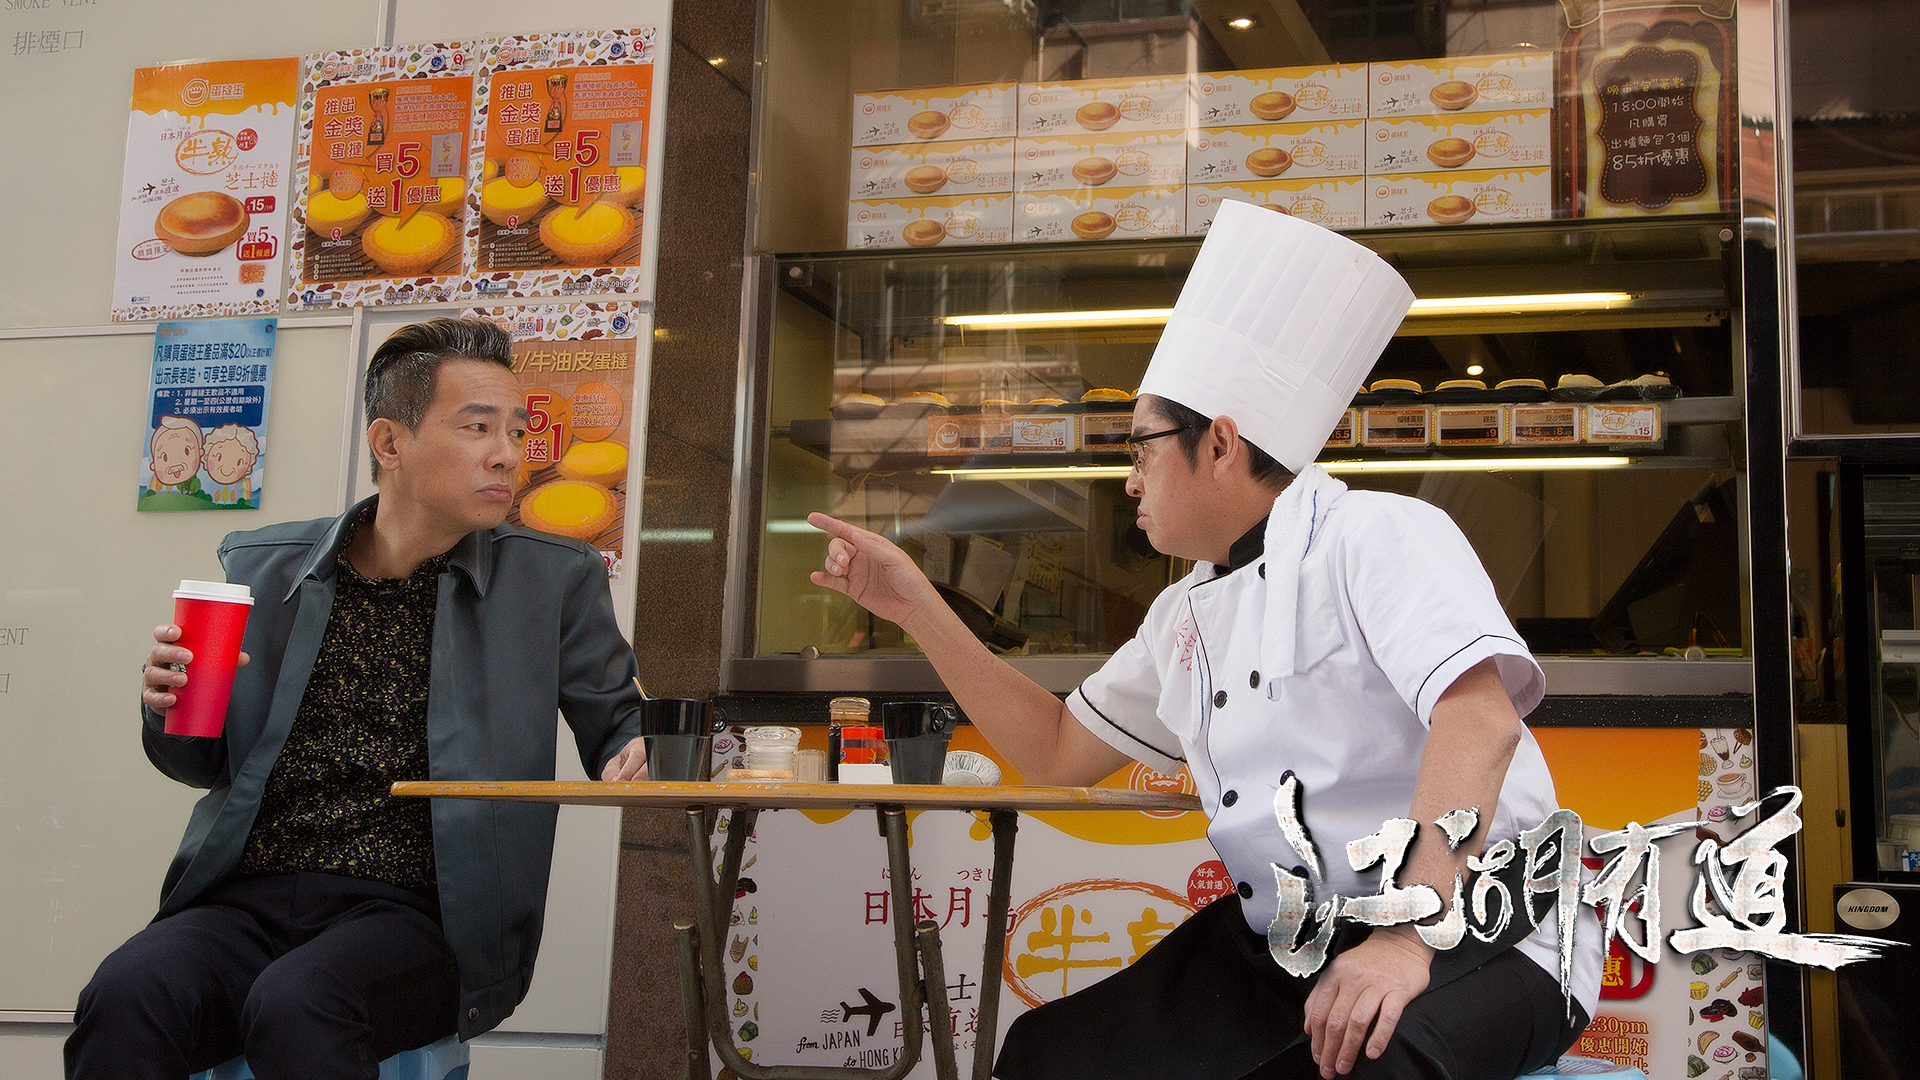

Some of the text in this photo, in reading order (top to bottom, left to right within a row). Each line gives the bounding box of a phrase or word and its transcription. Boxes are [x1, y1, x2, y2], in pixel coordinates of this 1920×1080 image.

[13, 29, 84, 56] 排煙口
[500, 83, 532, 101] 推出
[324, 97, 355, 116] 推出
[499, 102, 541, 125] 金獎
[324, 116, 364, 139] 金獎
[1629, 114, 1668, 128] 凡購買
[506, 127, 540, 146] 蛋撻
[330, 142, 363, 160] 蛋撻
[553, 129, 600, 167] 買5
[375, 142, 420, 178] 買5
[1612, 147, 1690, 171] 85折優惠
[223, 171, 278, 190] 芝士撻
[543, 166, 621, 203] 送1優惠
[366, 178, 441, 214] 送1優惠
[1634, 427, 1650, 436] $15
[1050, 437, 1064, 447] $15
[1197, 867, 1215, 878] 好食
[1187, 879, 1223, 890] 人氣首選
[796, 1030, 860, 1054] from JAPAN
[1580, 1036, 1648, 1055] 優惠開始
[844, 1053, 857, 1067] to
[859, 1048, 888, 1069] HONG
